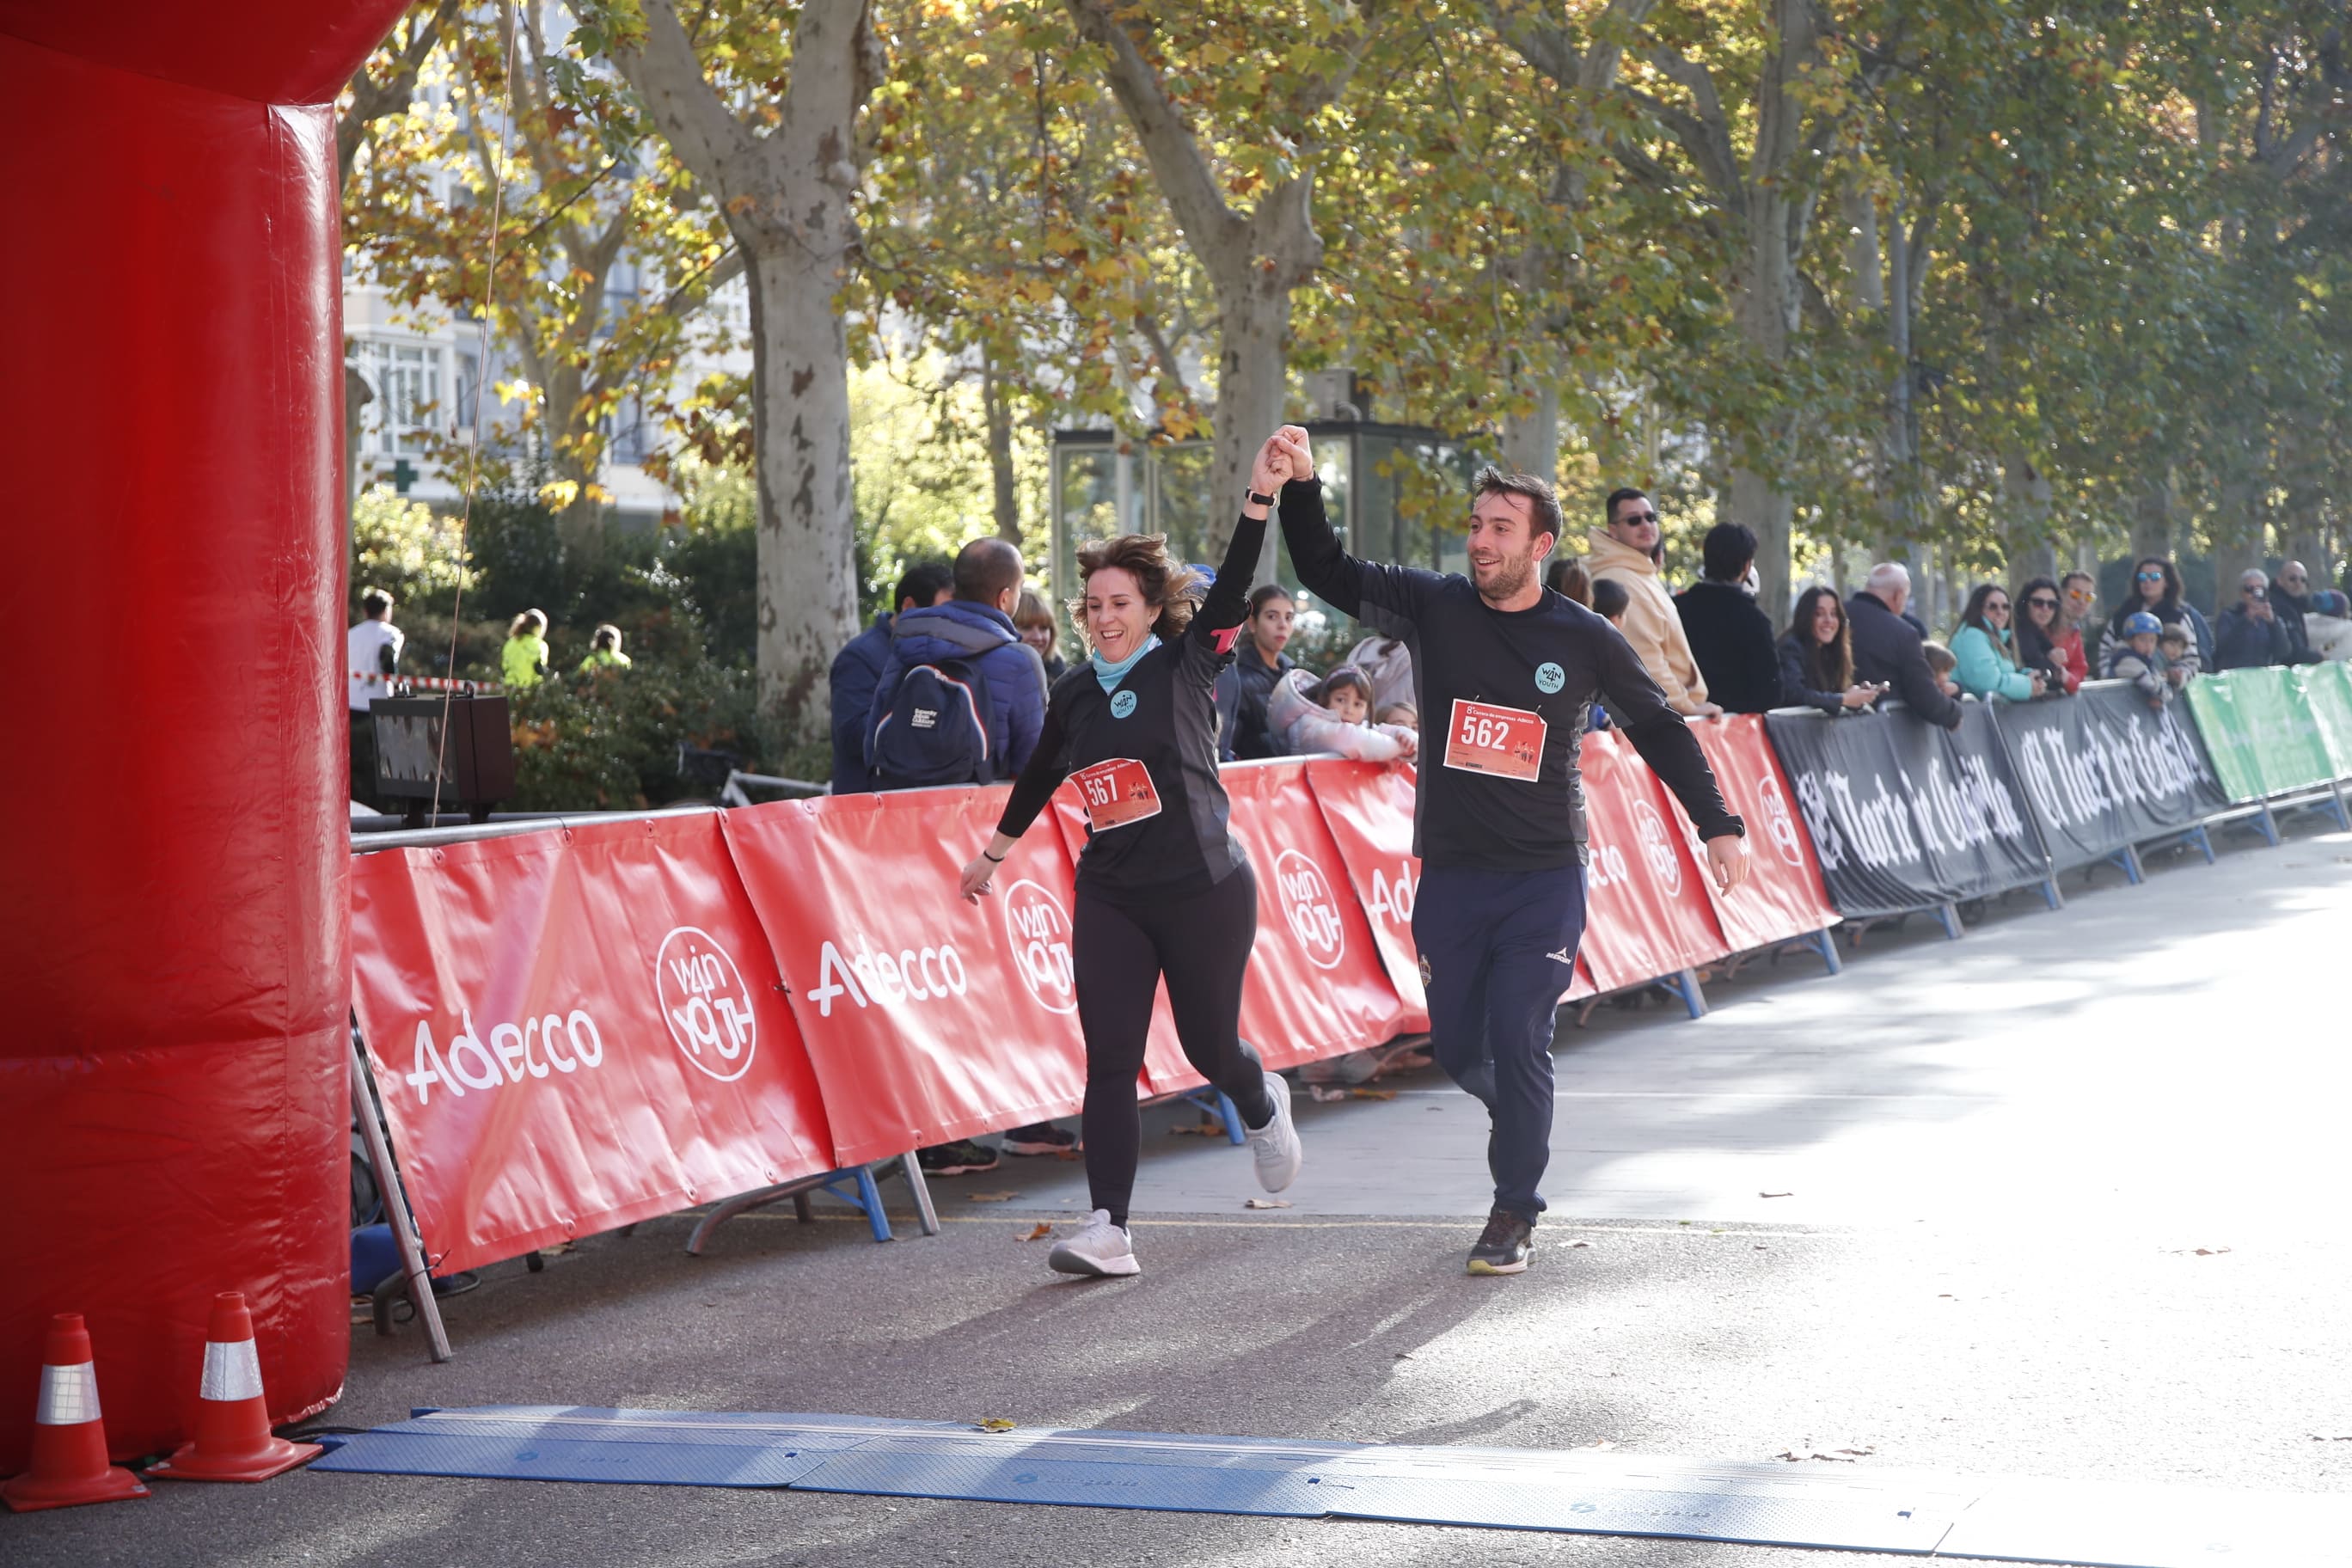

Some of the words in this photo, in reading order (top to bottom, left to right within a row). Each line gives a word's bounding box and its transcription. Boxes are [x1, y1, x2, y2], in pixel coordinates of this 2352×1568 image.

[1539, 679, 1559, 689] YOUTH
[1461, 715, 1510, 750] 562
[1084, 774, 1118, 806] 567
[806, 933, 967, 1018] Adecco
[671, 995, 756, 1061] YOUTH
[405, 1008, 603, 1106] Adecco
